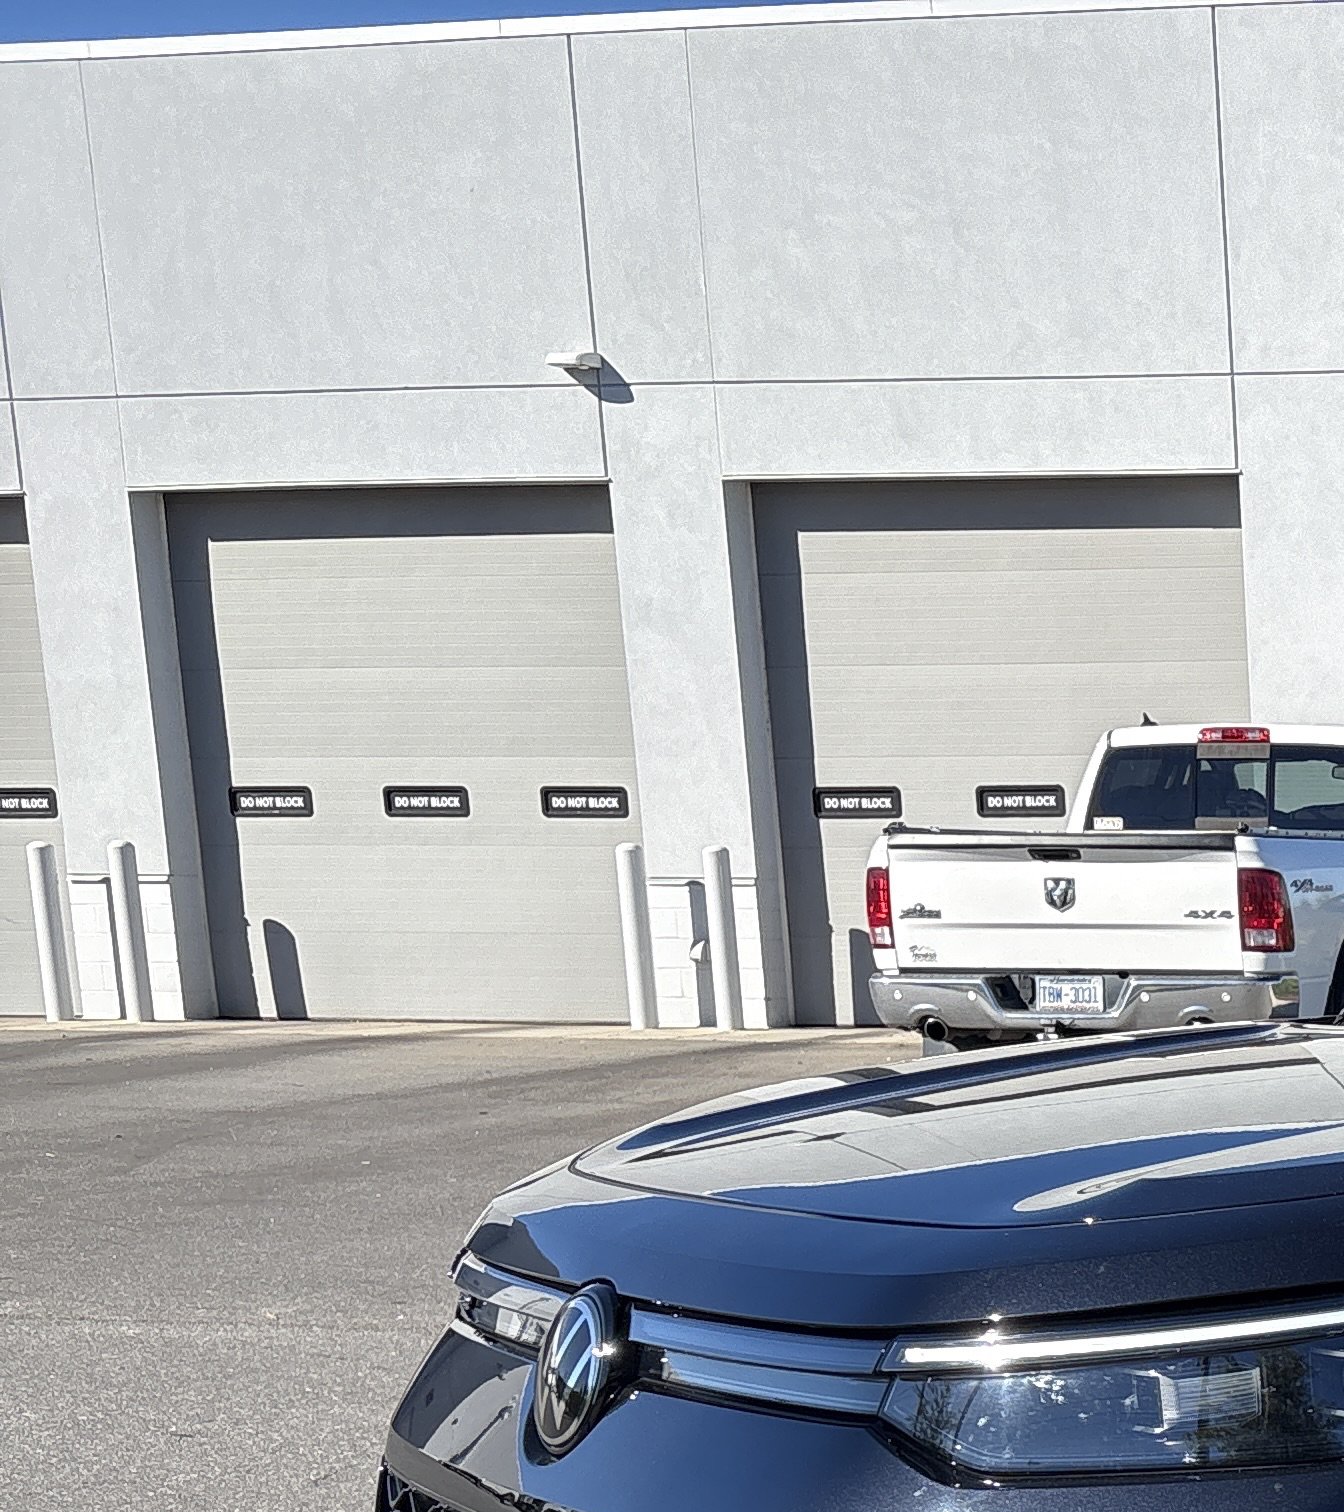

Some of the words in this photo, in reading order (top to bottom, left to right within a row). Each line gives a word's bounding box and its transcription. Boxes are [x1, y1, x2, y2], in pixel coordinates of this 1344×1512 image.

[1, 798, 20, 809] NOT
[21, 798, 50, 809] BLOCK
[240, 796, 255, 808] DO
[255, 796, 274, 808] NOT
[275, 796, 305, 808] BLOCK
[394, 796, 409, 808] DO
[410, 796, 430, 808] NOT
[430, 796, 461, 808] BLOCK
[551, 796, 567, 809] DO
[567, 796, 587, 809] NOT
[588, 796, 620, 809] BLOCK
[824, 797, 839, 809] DO
[840, 797, 860, 809] NOT
[861, 797, 893, 809] BLOCK
[987, 795, 1003, 808] DO
[1003, 795, 1024, 808] NOT
[1024, 795, 1057, 808] BLOCK
[1040, 985, 1100, 1004] TBW-3031
